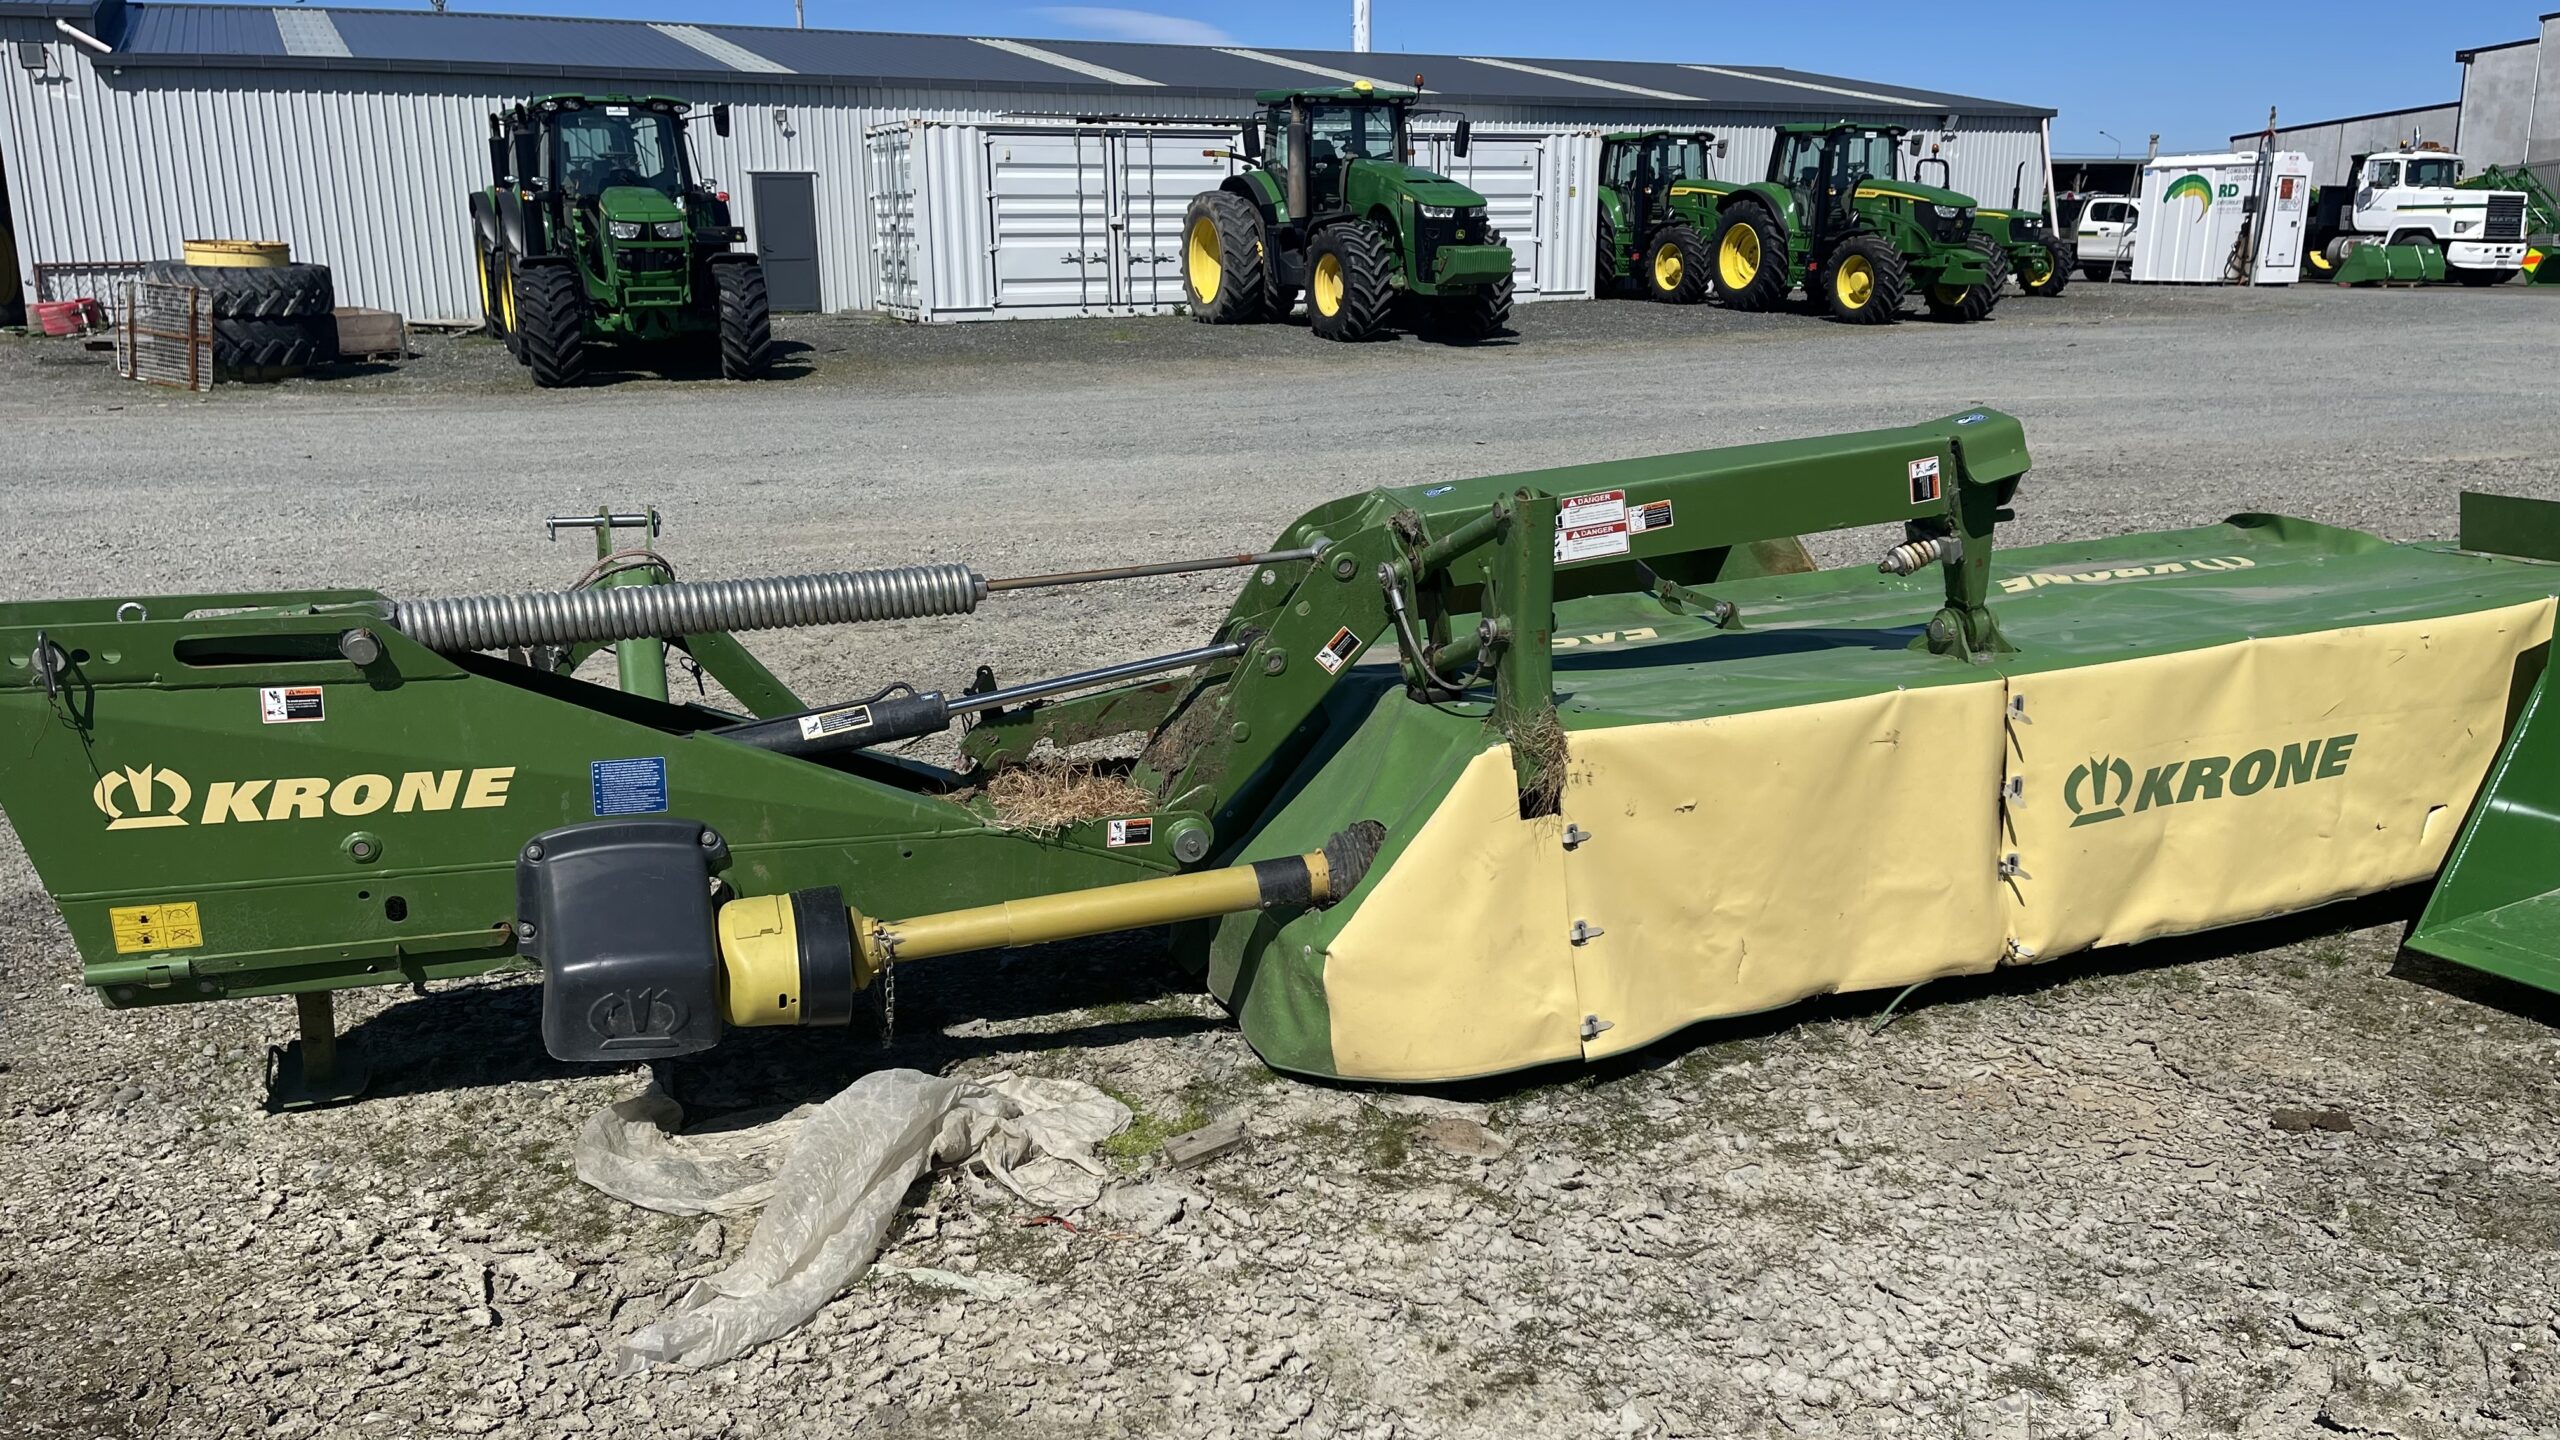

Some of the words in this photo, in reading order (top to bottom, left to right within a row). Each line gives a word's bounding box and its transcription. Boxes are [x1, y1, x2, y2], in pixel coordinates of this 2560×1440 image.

[2218, 183, 2239, 198] RD
[1577, 493, 1611, 505] DANGER
[1581, 525, 1614, 537] DANGER
[1996, 563, 2187, 593] KRONE
[2133, 733, 2358, 813] KRONE
[201, 766, 516, 825] KRONE
